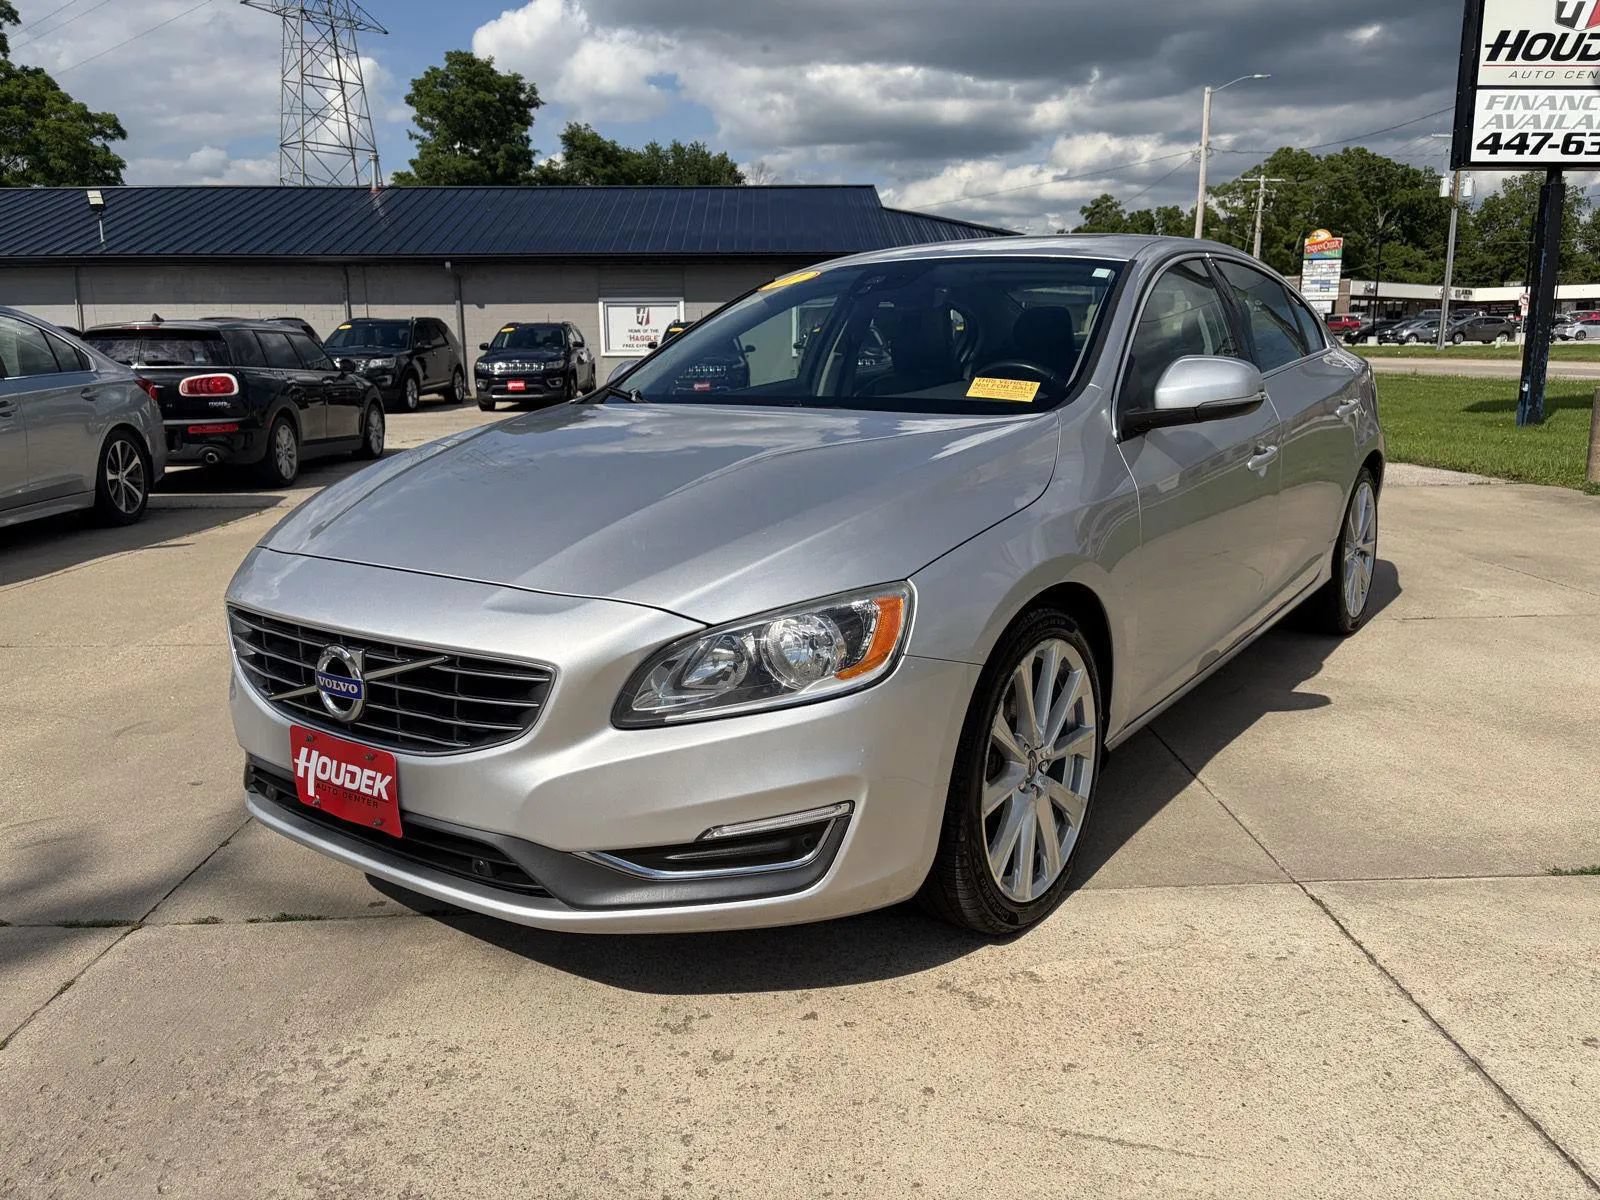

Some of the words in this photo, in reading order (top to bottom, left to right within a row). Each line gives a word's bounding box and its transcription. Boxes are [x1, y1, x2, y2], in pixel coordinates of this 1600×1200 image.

[1508, 70, 1555, 79] AUTO
[1484, 95, 1600, 110] FINANC
[1482, 114, 1600, 130] AVAILA
[1476, 132, 1600, 156] 447-63
[317, 675, 358, 694] VOLVO
[294, 747, 392, 800] HOUDEK
[316, 783, 337, 795] AUTO
[343, 792, 378, 808] CENTER
